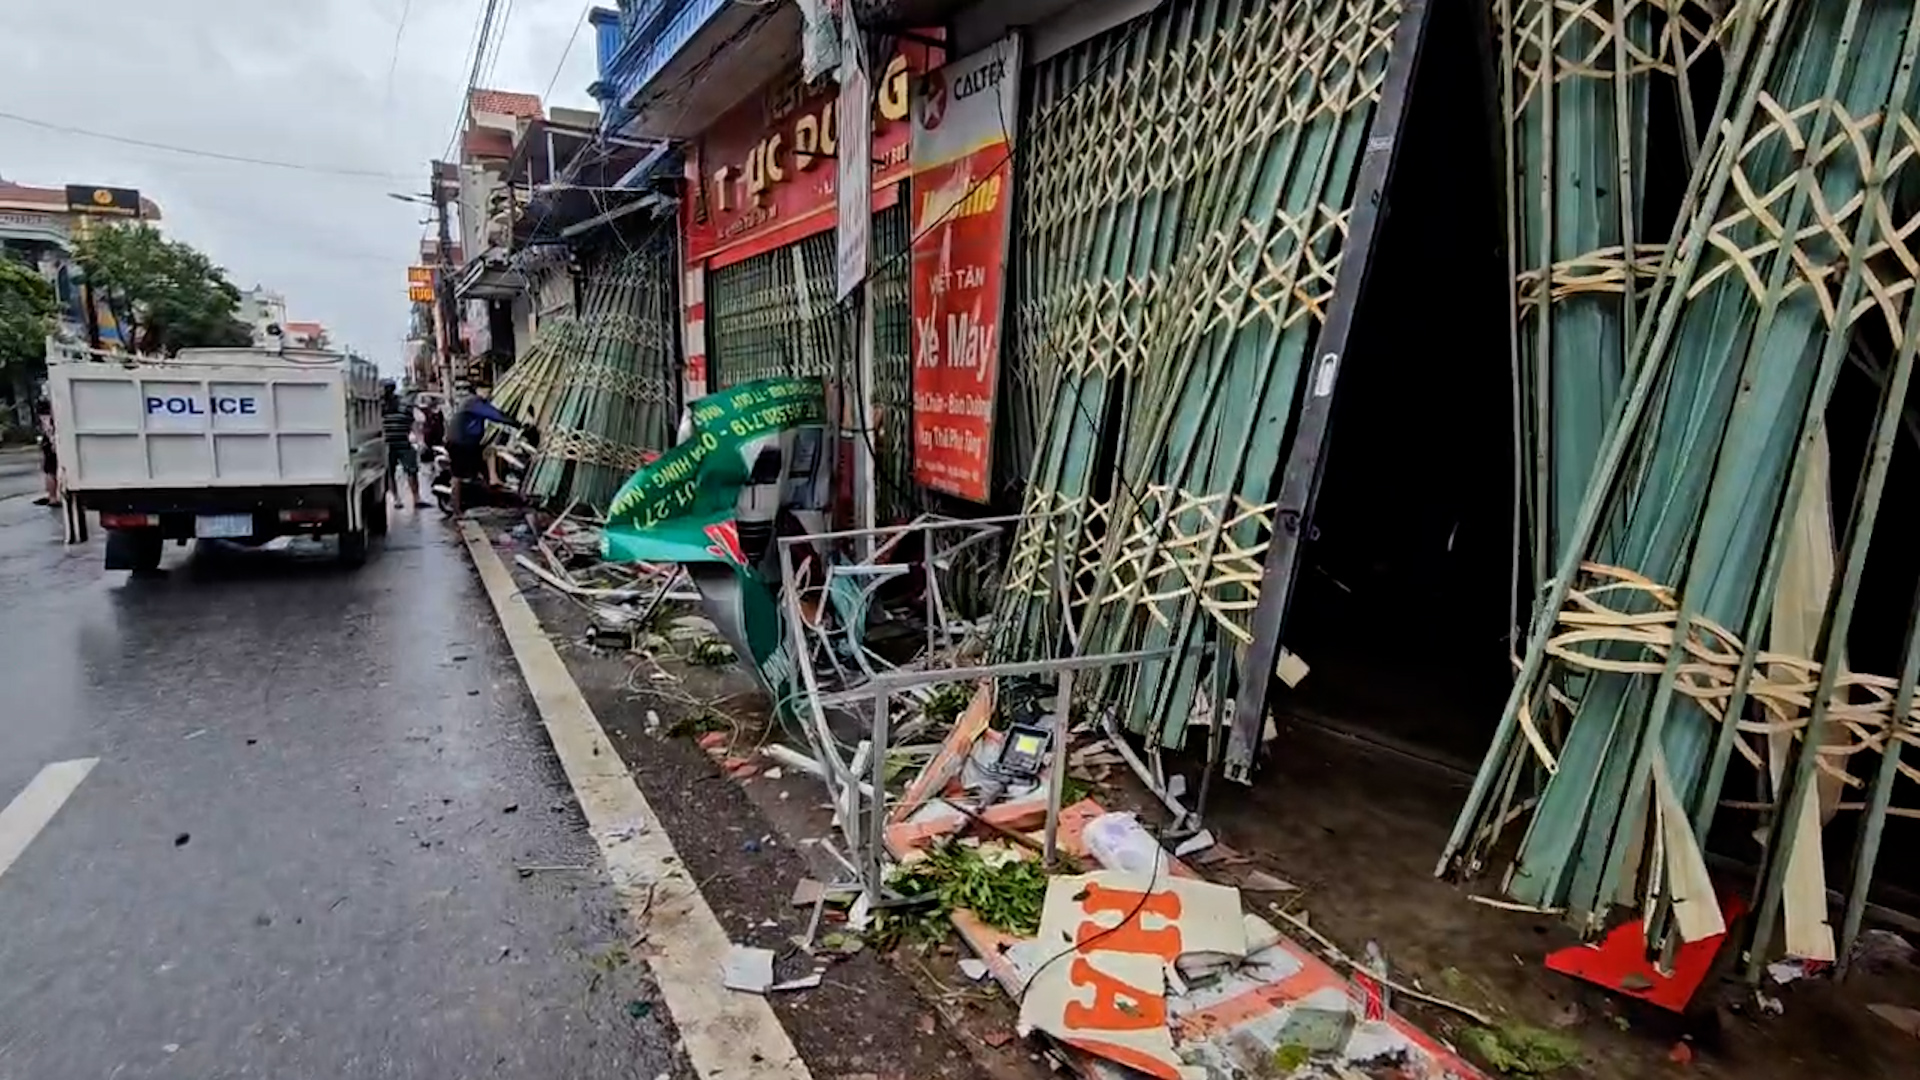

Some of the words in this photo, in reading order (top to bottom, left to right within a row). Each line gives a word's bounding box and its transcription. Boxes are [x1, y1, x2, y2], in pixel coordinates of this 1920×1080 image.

[954, 57, 1007, 100] CALTEX
[947, 311, 994, 382] Máy
[146, 396, 257, 416] POLICE
